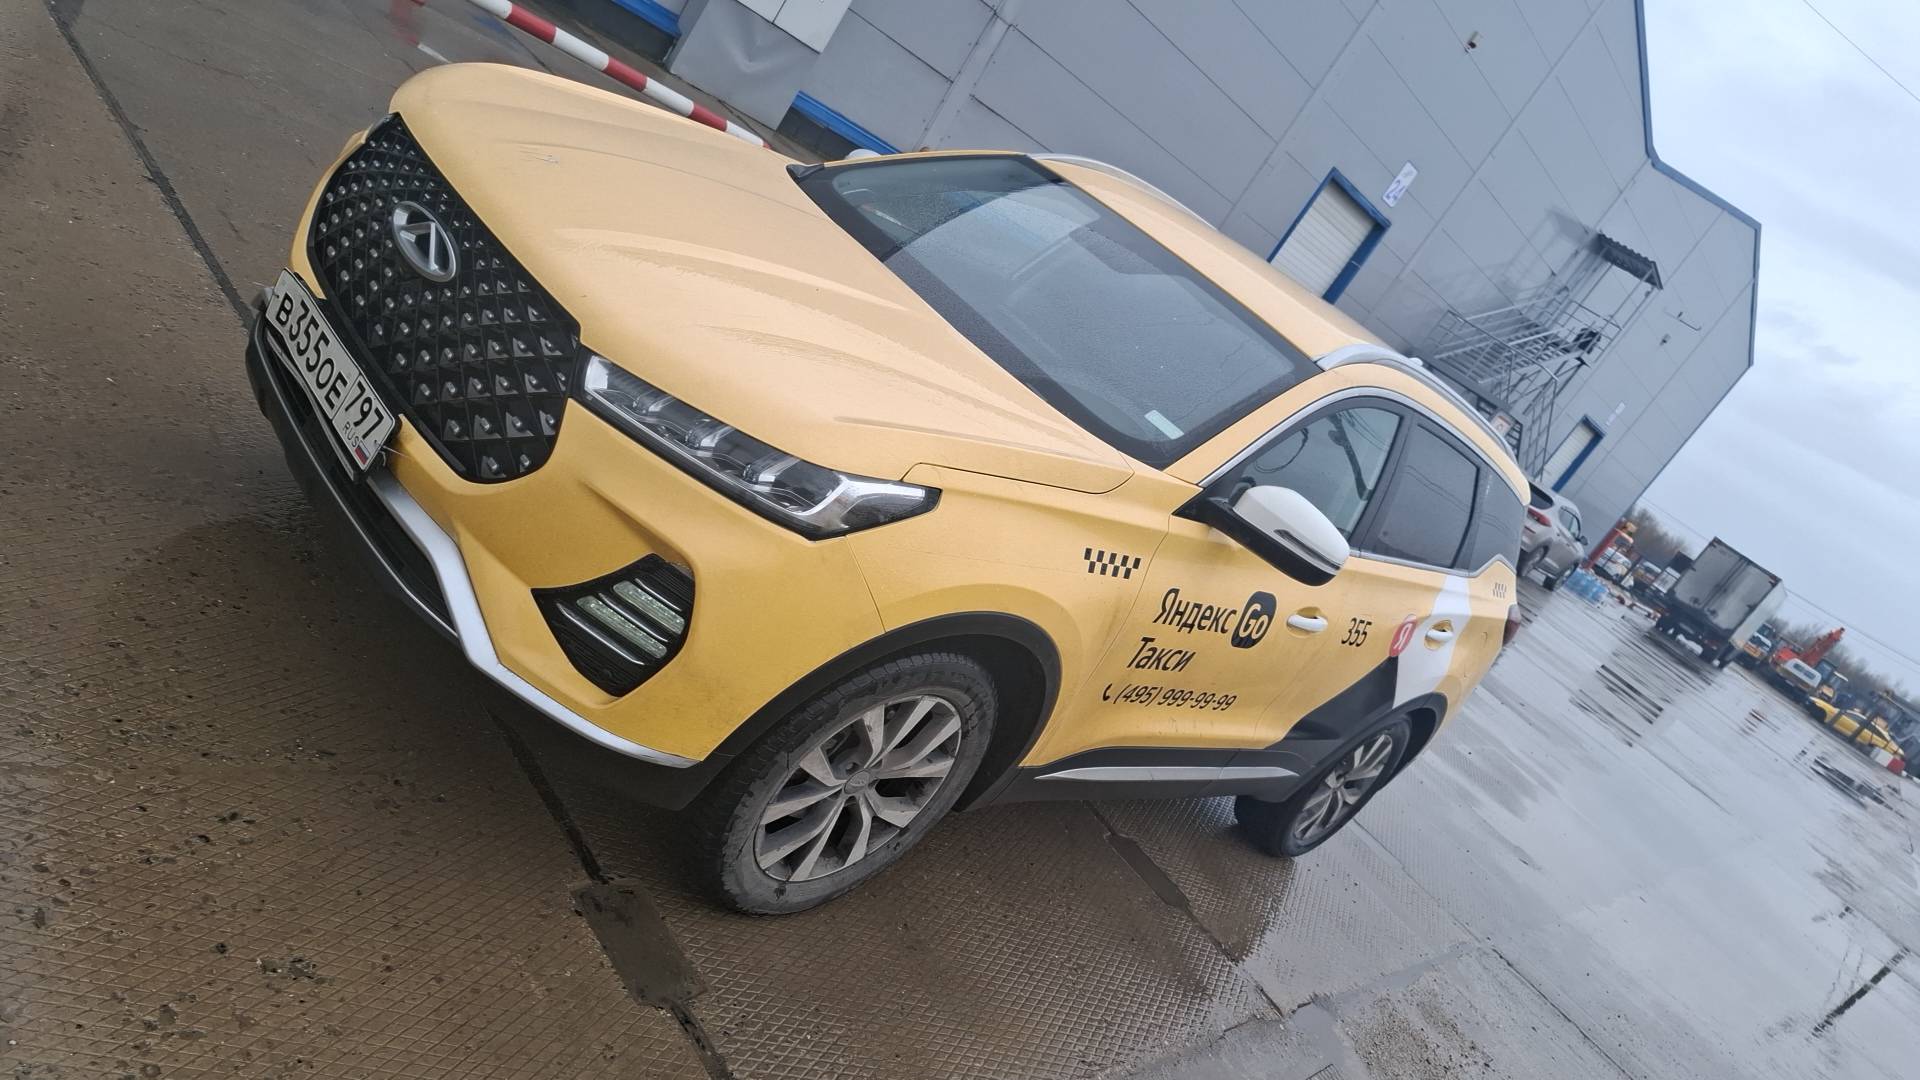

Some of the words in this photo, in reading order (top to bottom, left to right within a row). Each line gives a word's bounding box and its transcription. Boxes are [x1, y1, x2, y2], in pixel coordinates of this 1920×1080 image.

[345, 380, 385, 440] 797
[341, 421, 360, 448] RUS
[1152, 587, 1238, 634] Яндекс
[1237, 602, 1271, 641] Go
[1340, 617, 1372, 648] 355
[1126, 636, 1196, 672] Такси
[1113, 683, 1163, 707] (495)
[1157, 688, 1237, 711] 999-99-99
